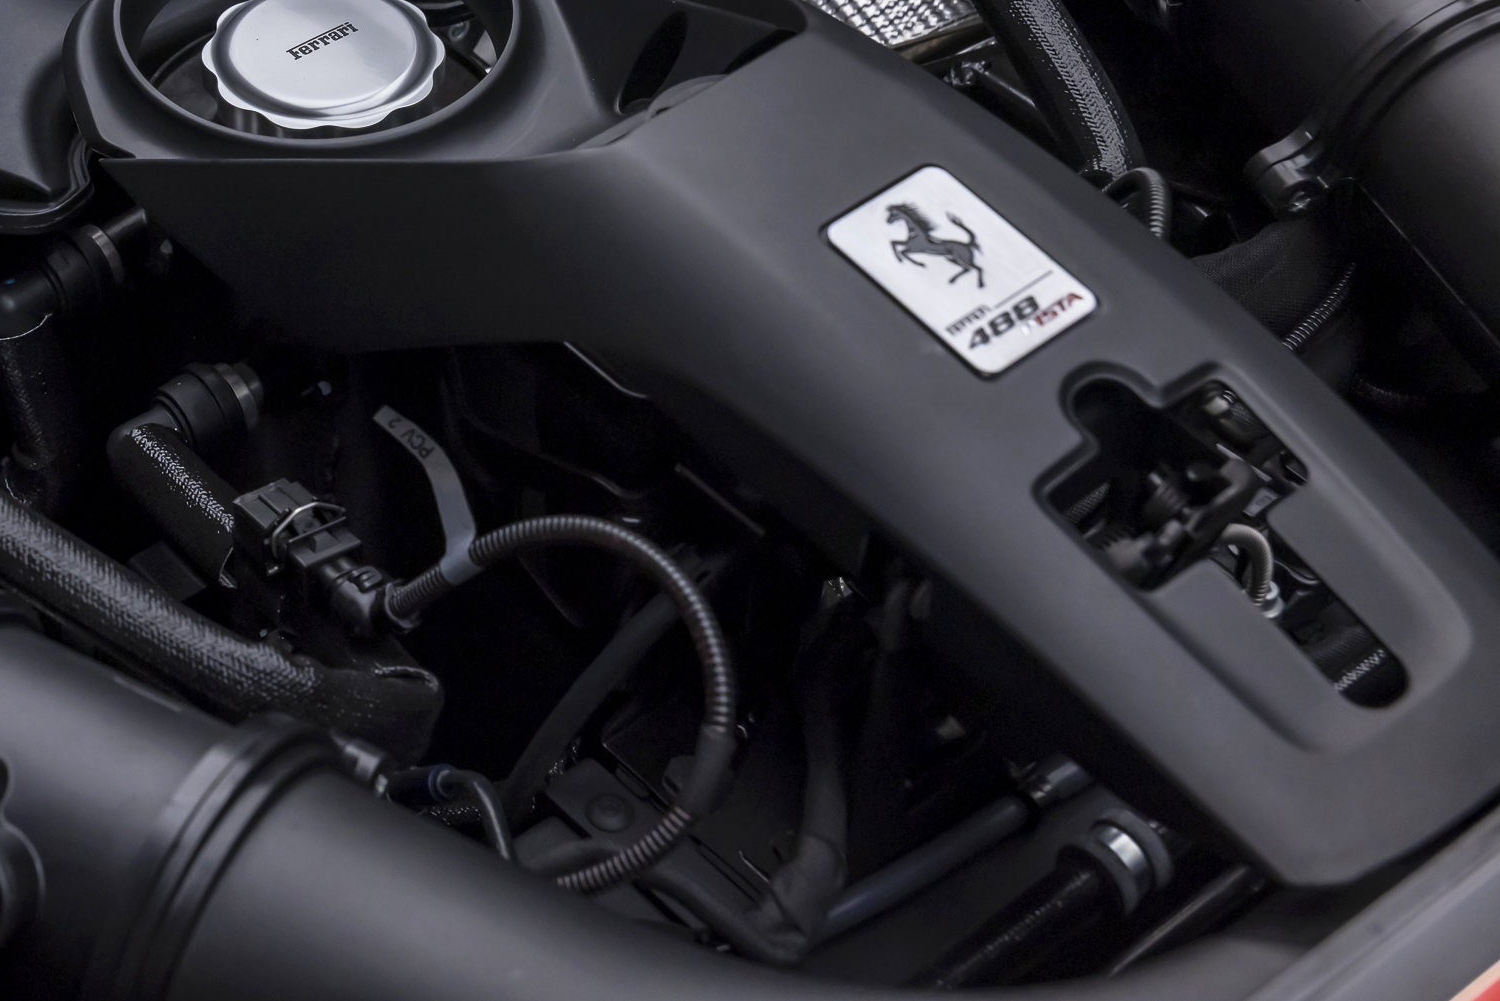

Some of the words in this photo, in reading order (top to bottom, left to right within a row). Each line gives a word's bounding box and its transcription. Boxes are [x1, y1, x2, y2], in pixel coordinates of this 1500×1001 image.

[285, 21, 359, 60] Ferrari
[968, 295, 1040, 350] 488
[387, 417, 402, 429] 2
[400, 428, 435, 459] PCV
